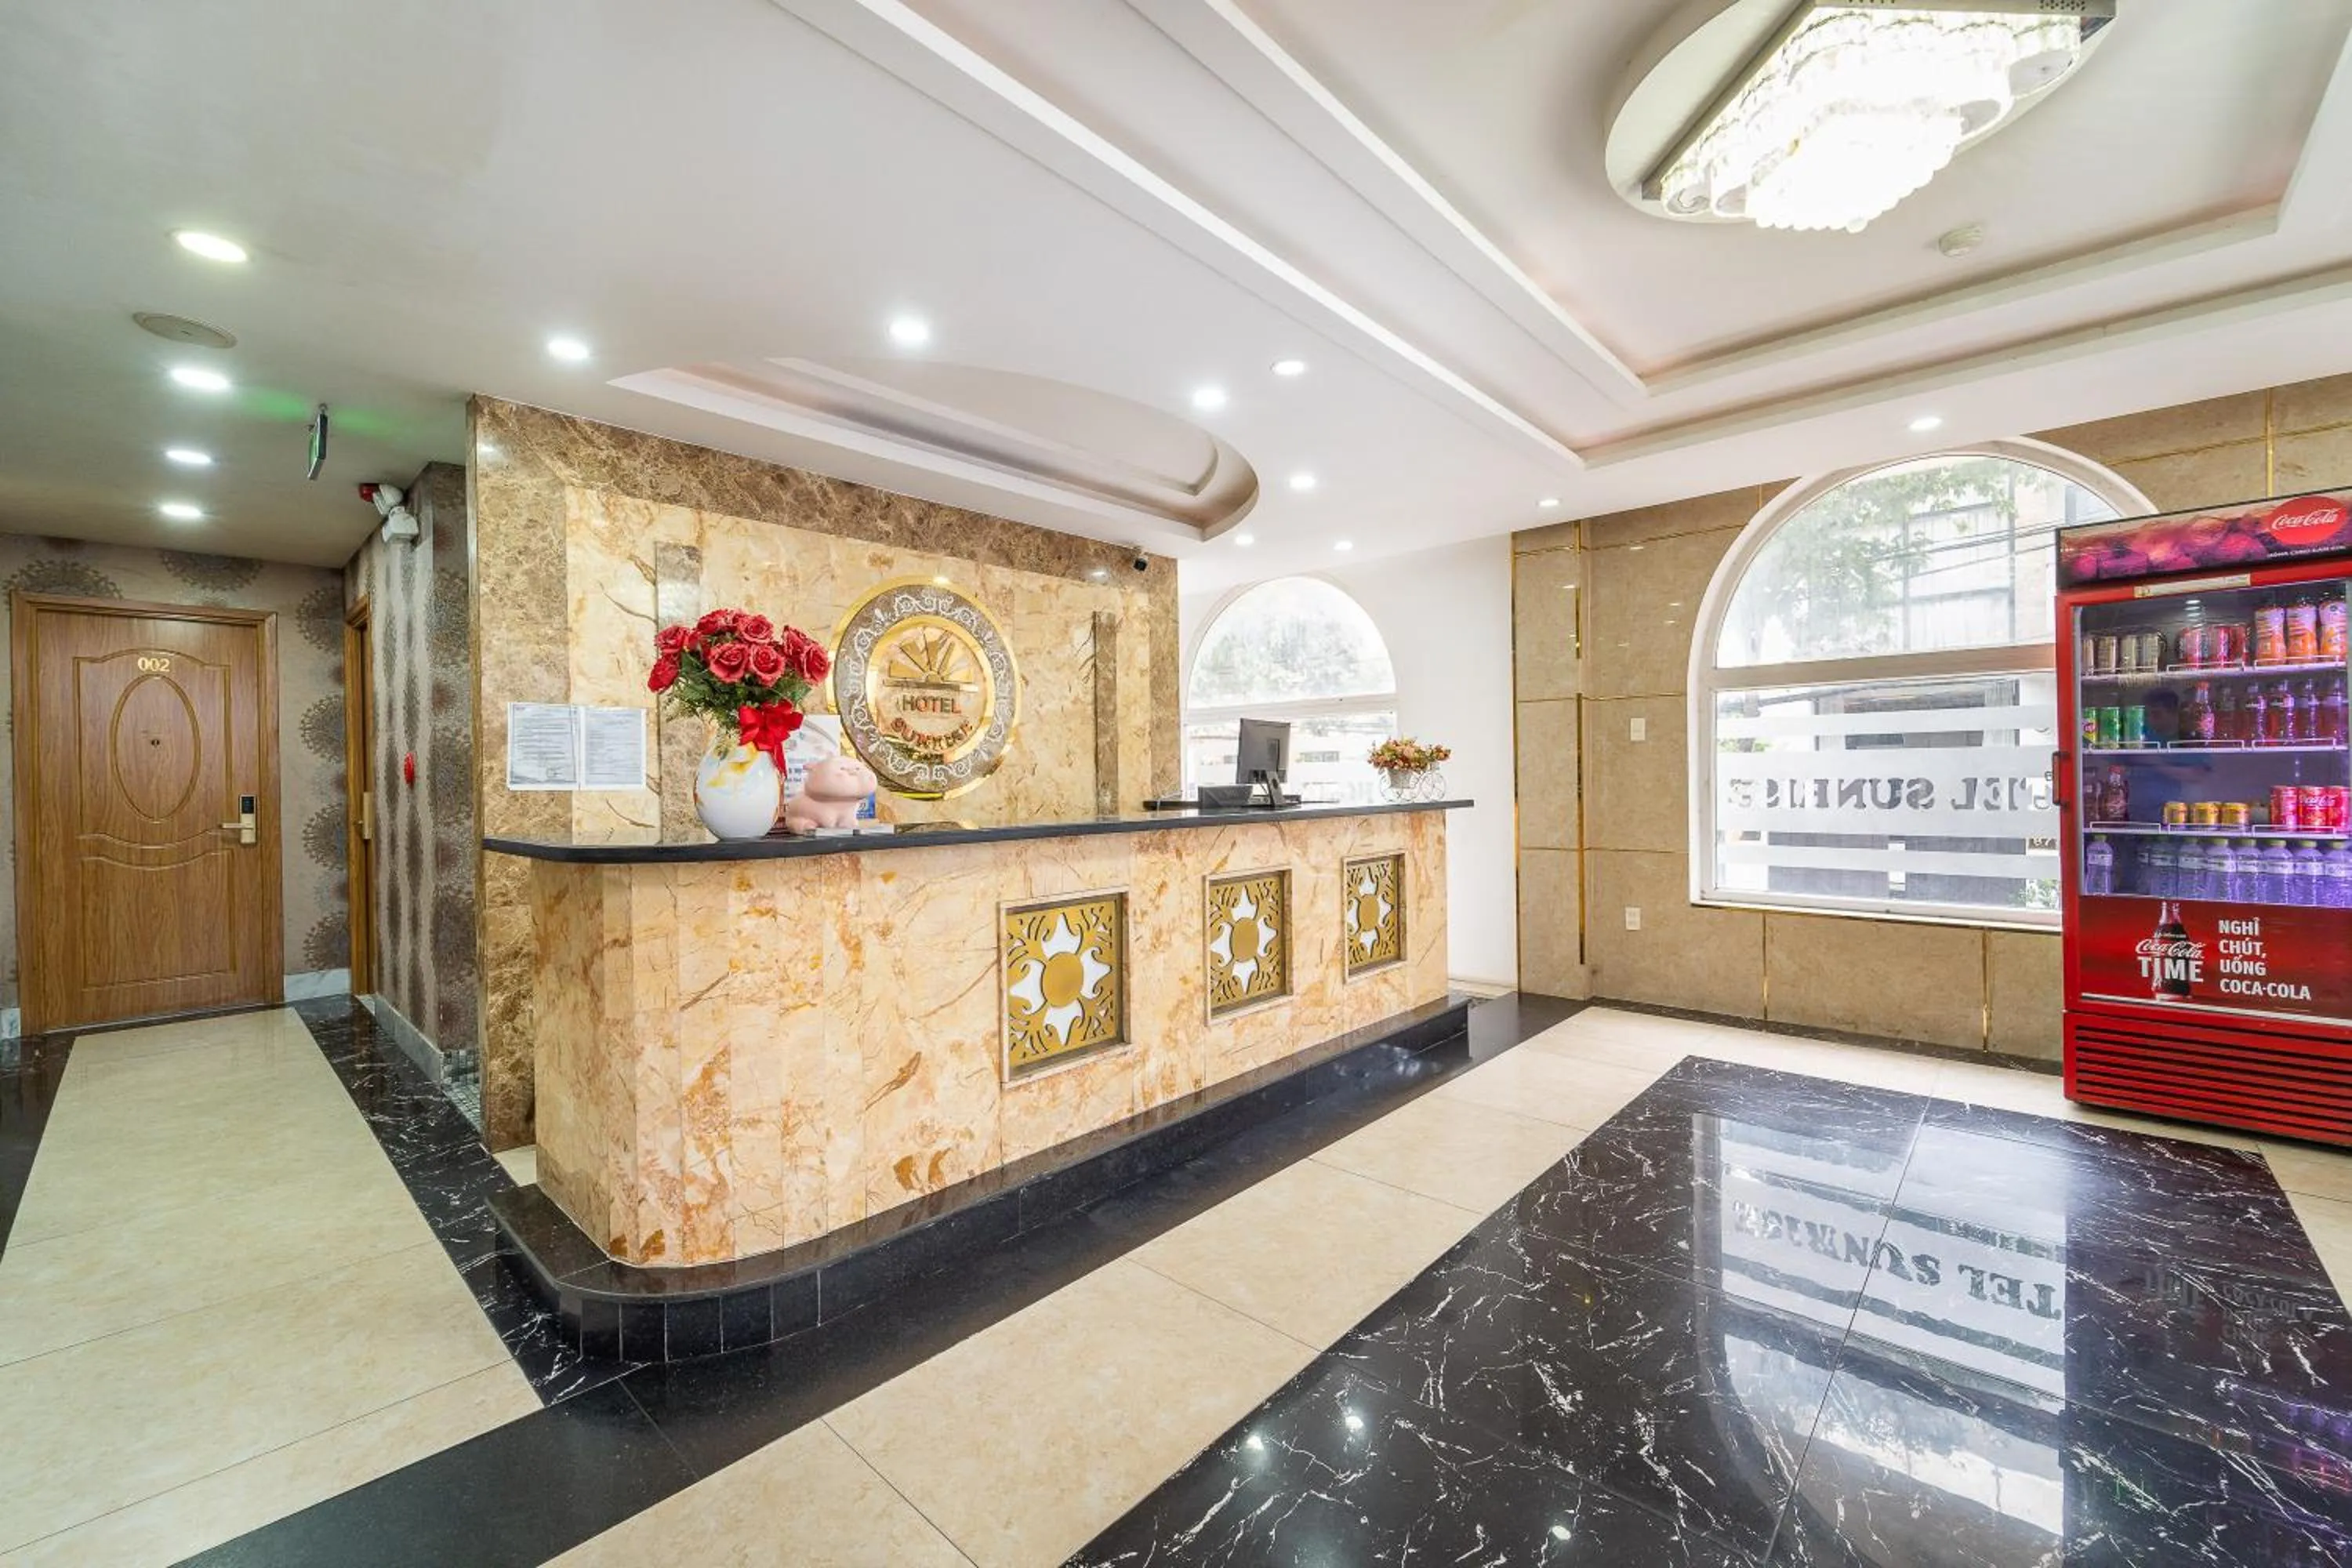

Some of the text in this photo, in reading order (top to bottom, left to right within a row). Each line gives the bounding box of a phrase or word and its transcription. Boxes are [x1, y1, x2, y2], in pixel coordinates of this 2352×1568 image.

[2271, 509, 2341, 532] Coca-Cola
[137, 657, 170, 673] 002
[902, 695, 962, 714] HOTEL
[2218, 916, 2261, 936] NGHỈ
[2135, 938, 2207, 960] Coca-Cola
[2218, 937, 2267, 958] CHÚT,
[2136, 956, 2205, 983] TIME
[2219, 954, 2267, 976] UỐNG
[2220, 978, 2312, 1000] COCA-COLA
